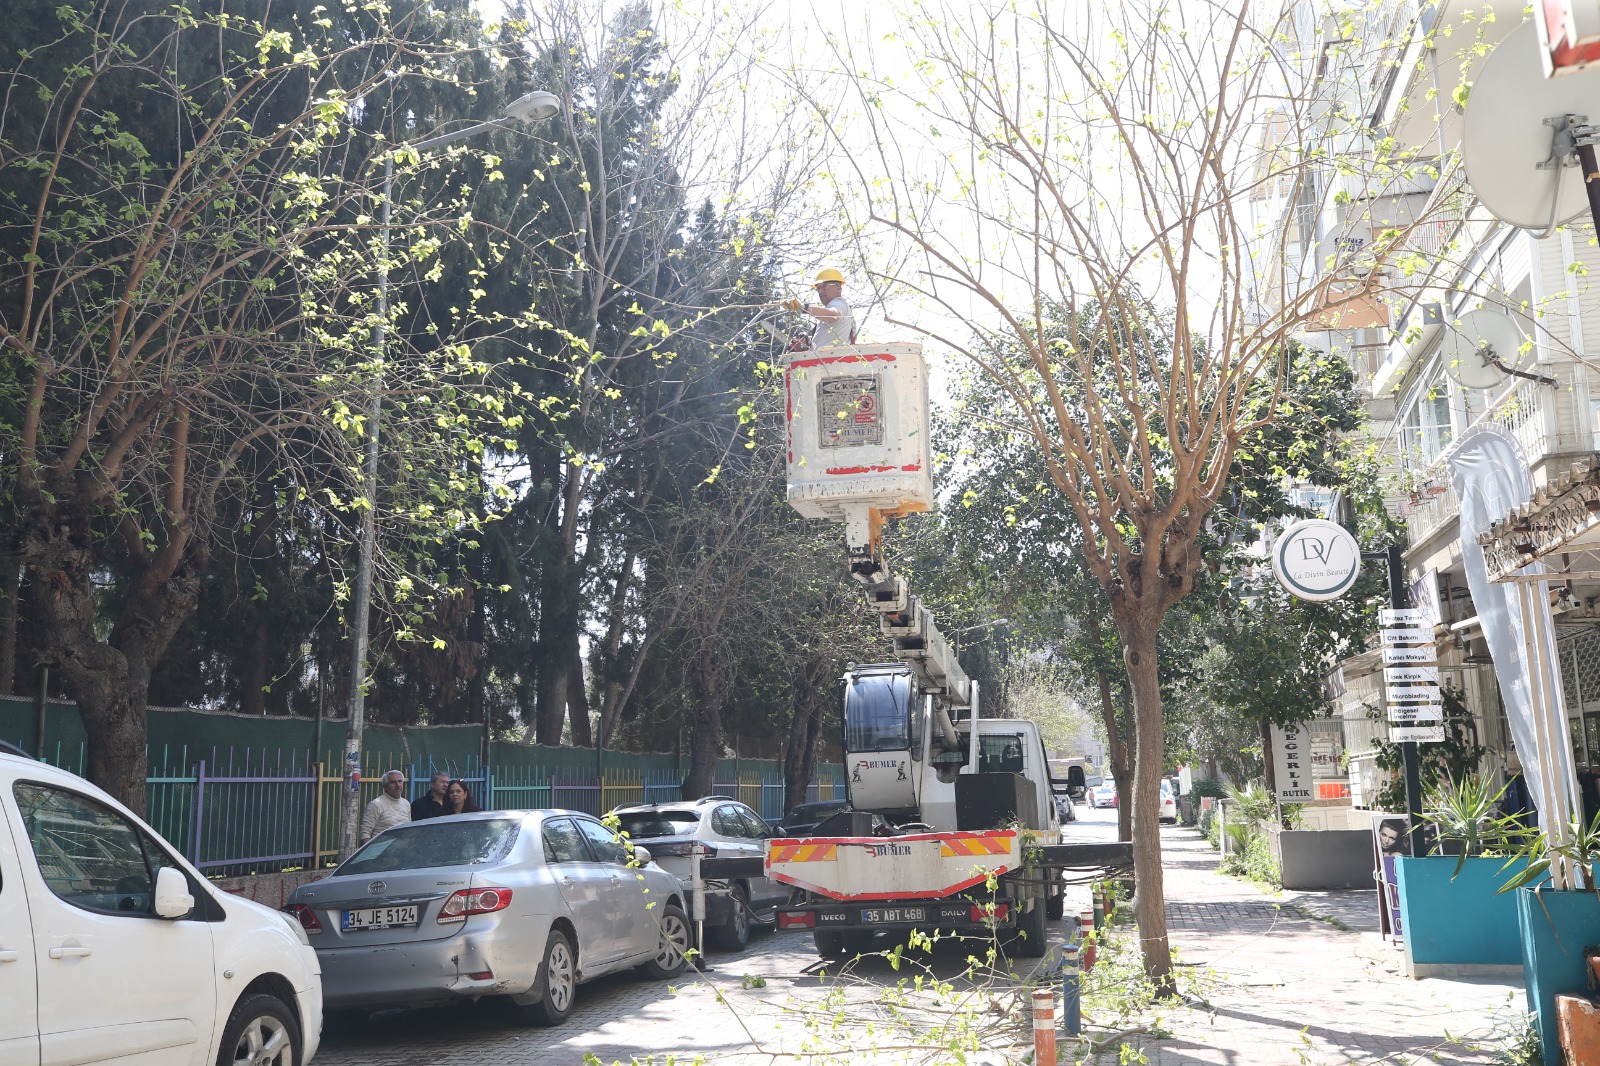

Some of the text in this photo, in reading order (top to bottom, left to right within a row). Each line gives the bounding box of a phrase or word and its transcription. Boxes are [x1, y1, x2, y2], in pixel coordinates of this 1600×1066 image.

[877, 845, 911, 856] BUMER
[349, 908, 414, 926] 34 JE 5124
[820, 913, 846, 921] IVECO
[867, 908, 922, 922] 35 ABT 468
[941, 909, 966, 917] DAILY
